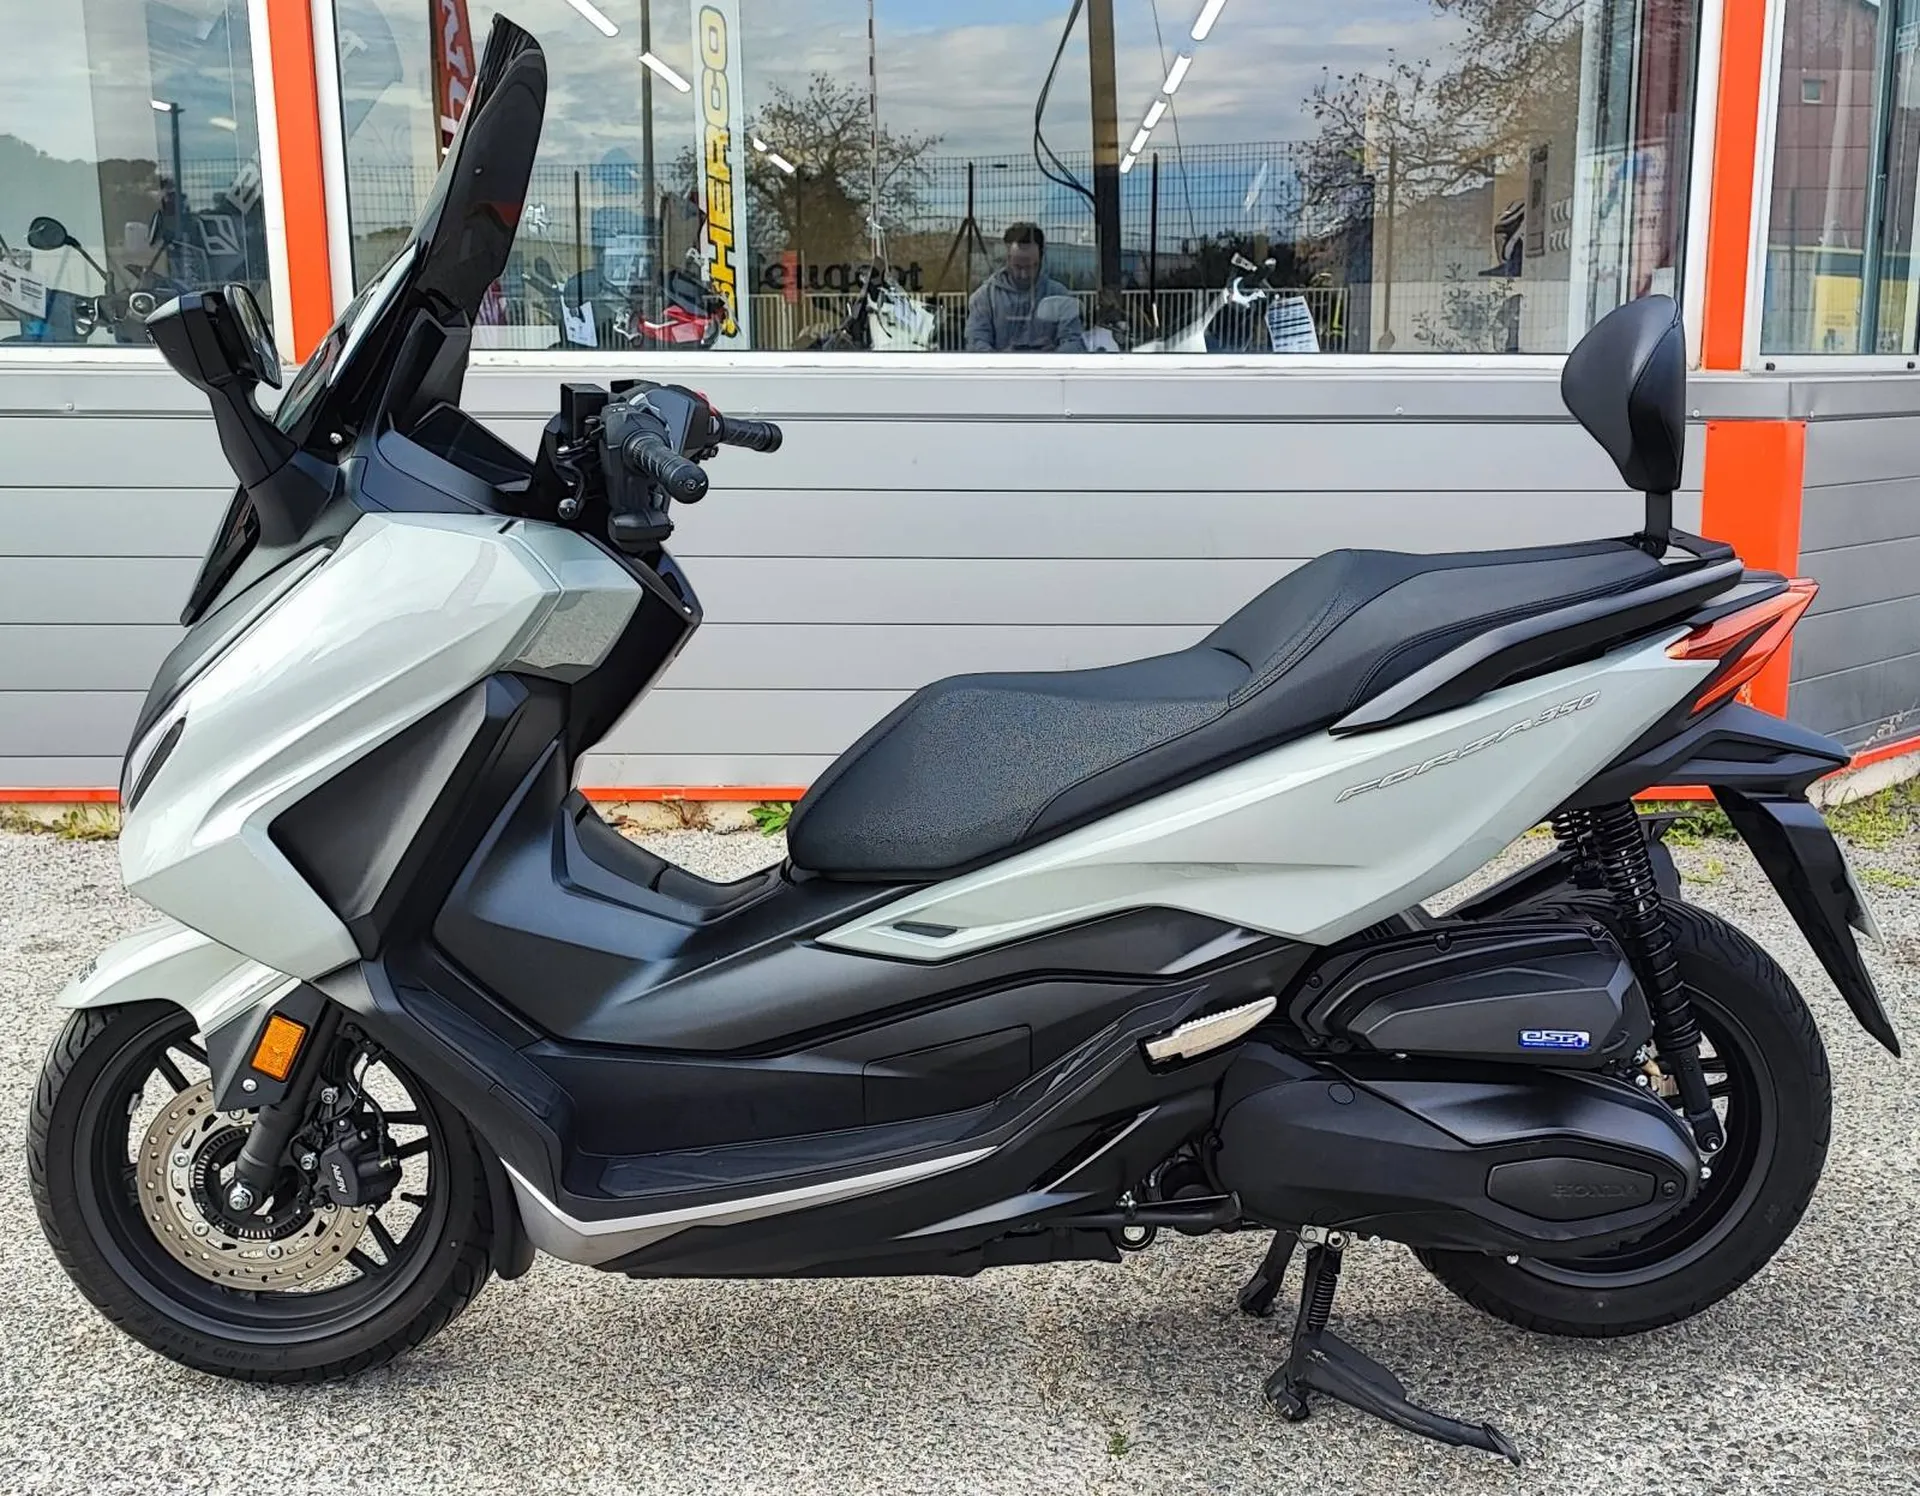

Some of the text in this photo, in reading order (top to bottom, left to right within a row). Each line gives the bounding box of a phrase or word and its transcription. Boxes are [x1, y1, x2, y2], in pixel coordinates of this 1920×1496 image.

[699, 5, 738, 338] SHERCO
[1335, 690, 1600, 803] FORZA 350
[1551, 1183, 1640, 1199] HONDA
